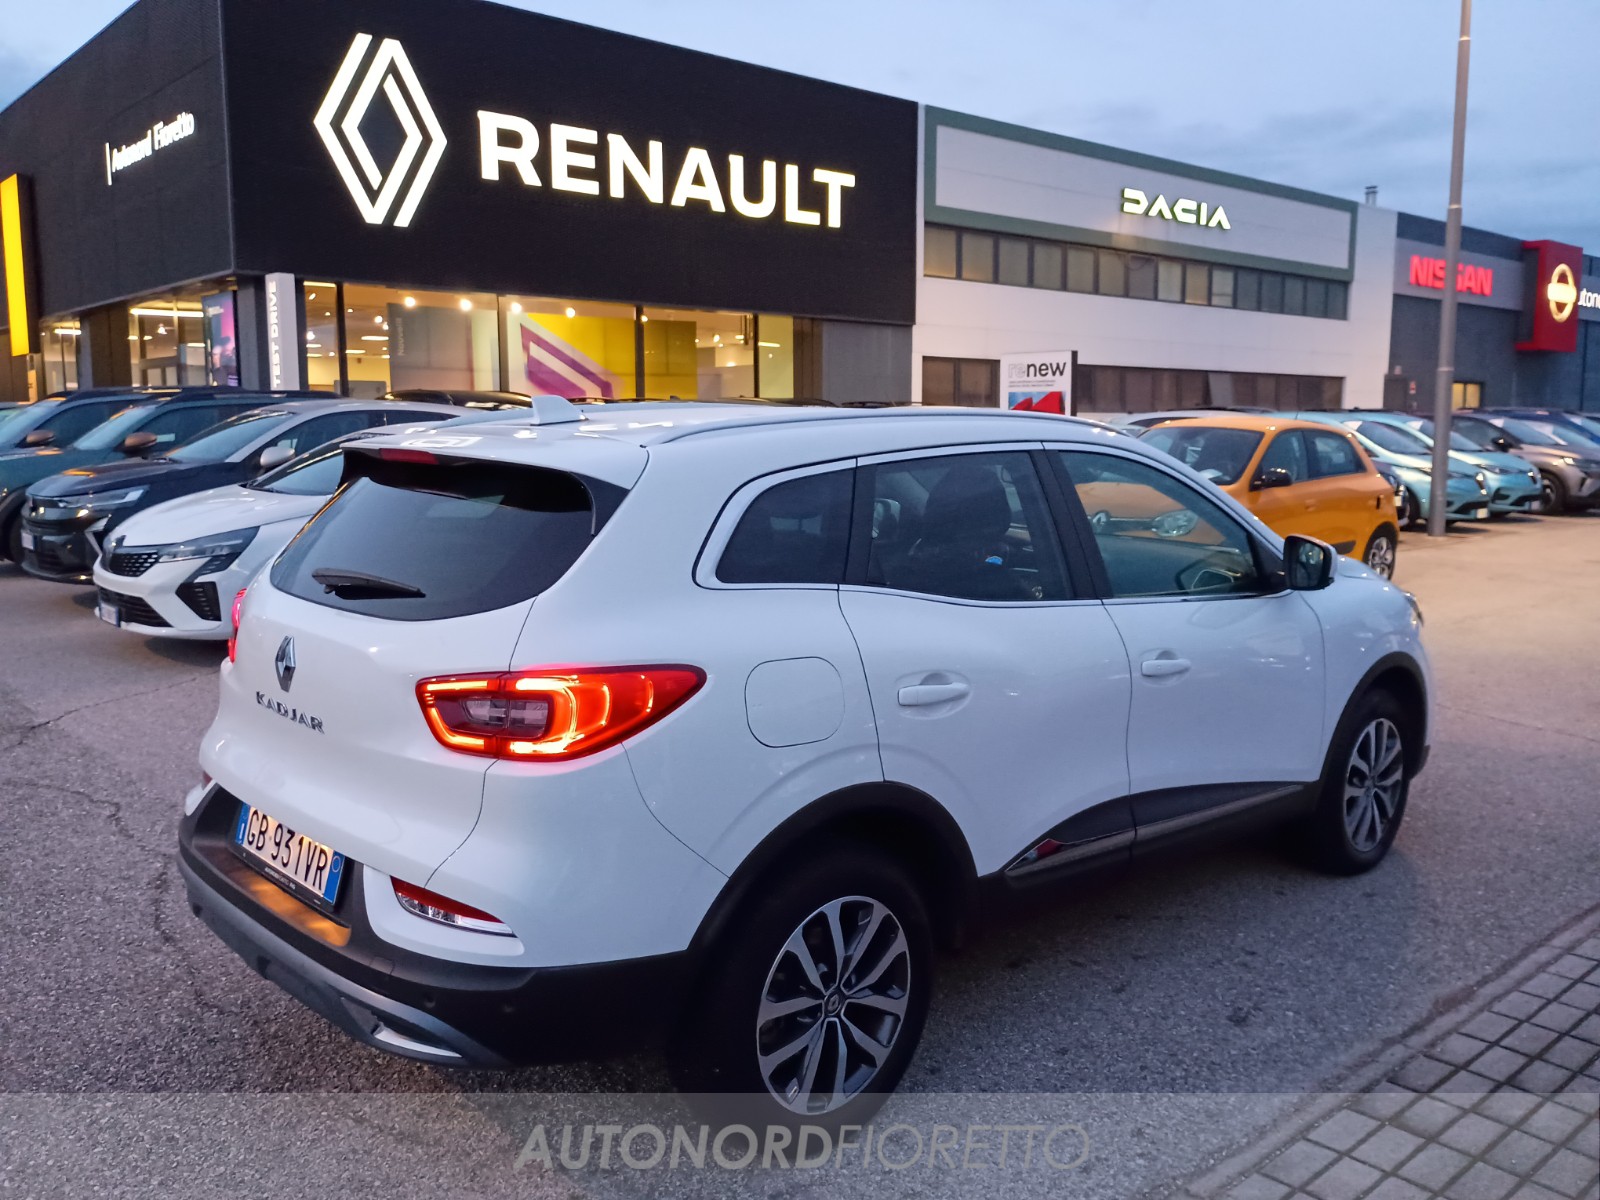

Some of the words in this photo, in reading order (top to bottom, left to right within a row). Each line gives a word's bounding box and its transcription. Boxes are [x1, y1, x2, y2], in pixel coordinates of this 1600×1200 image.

[477, 109, 856, 229] RENAULT
[1123, 187, 1231, 230] DACIA
[268, 281, 279, 338] DRIVE
[270, 341, 281, 389] TEST
[256, 691, 325, 734] KADJAR
